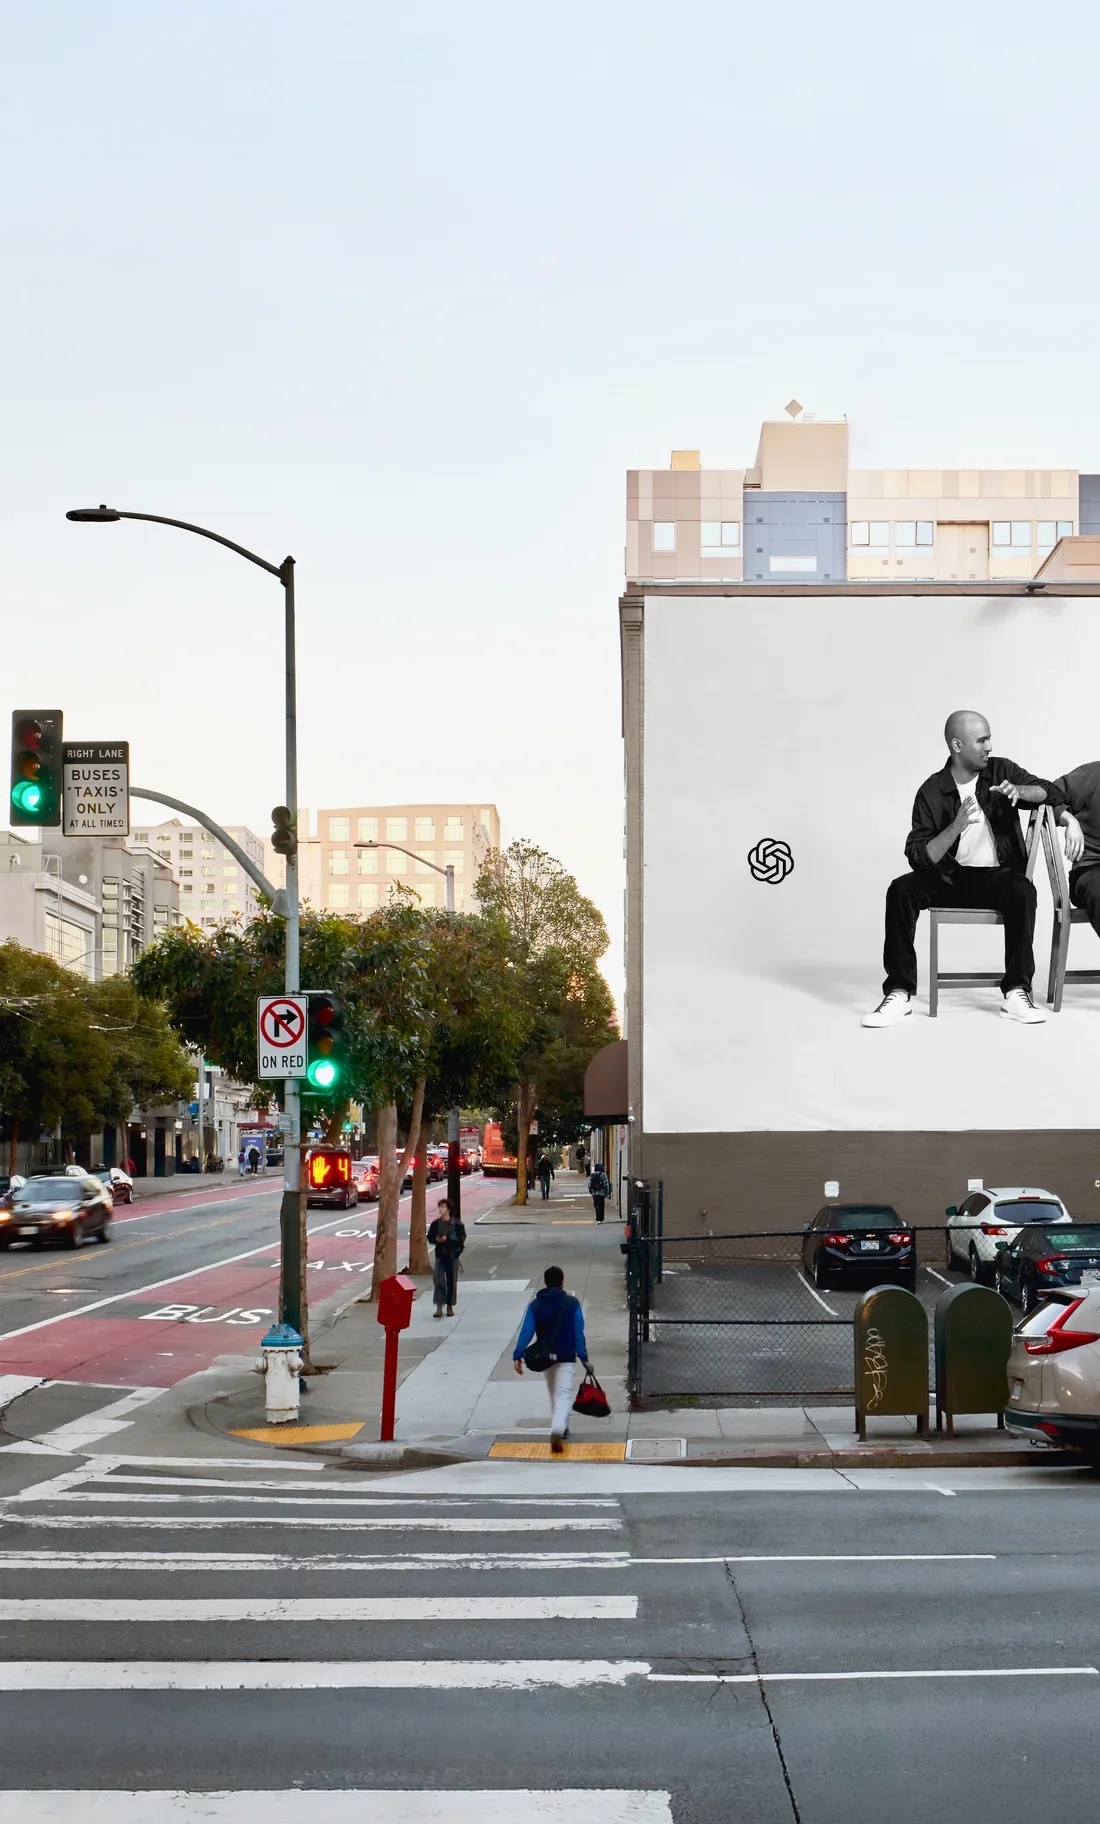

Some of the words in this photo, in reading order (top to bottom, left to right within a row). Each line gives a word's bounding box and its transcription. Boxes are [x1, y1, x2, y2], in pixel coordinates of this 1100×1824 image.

[67, 749, 94, 758] RIGHT
[99, 749, 123, 758] LANE
[72, 769, 120, 781] BUSES
[74, 786, 117, 797] TAXIS
[76, 803, 116, 814] ONLY
[69, 819, 79, 828] AT
[81, 819, 96, 828] ALL
[262, 1055, 277, 1069] ON
[281, 1055, 304, 1068] RED
[338, 1158, 348, 1181] 4
[137, 1304, 273, 1324] BUS
